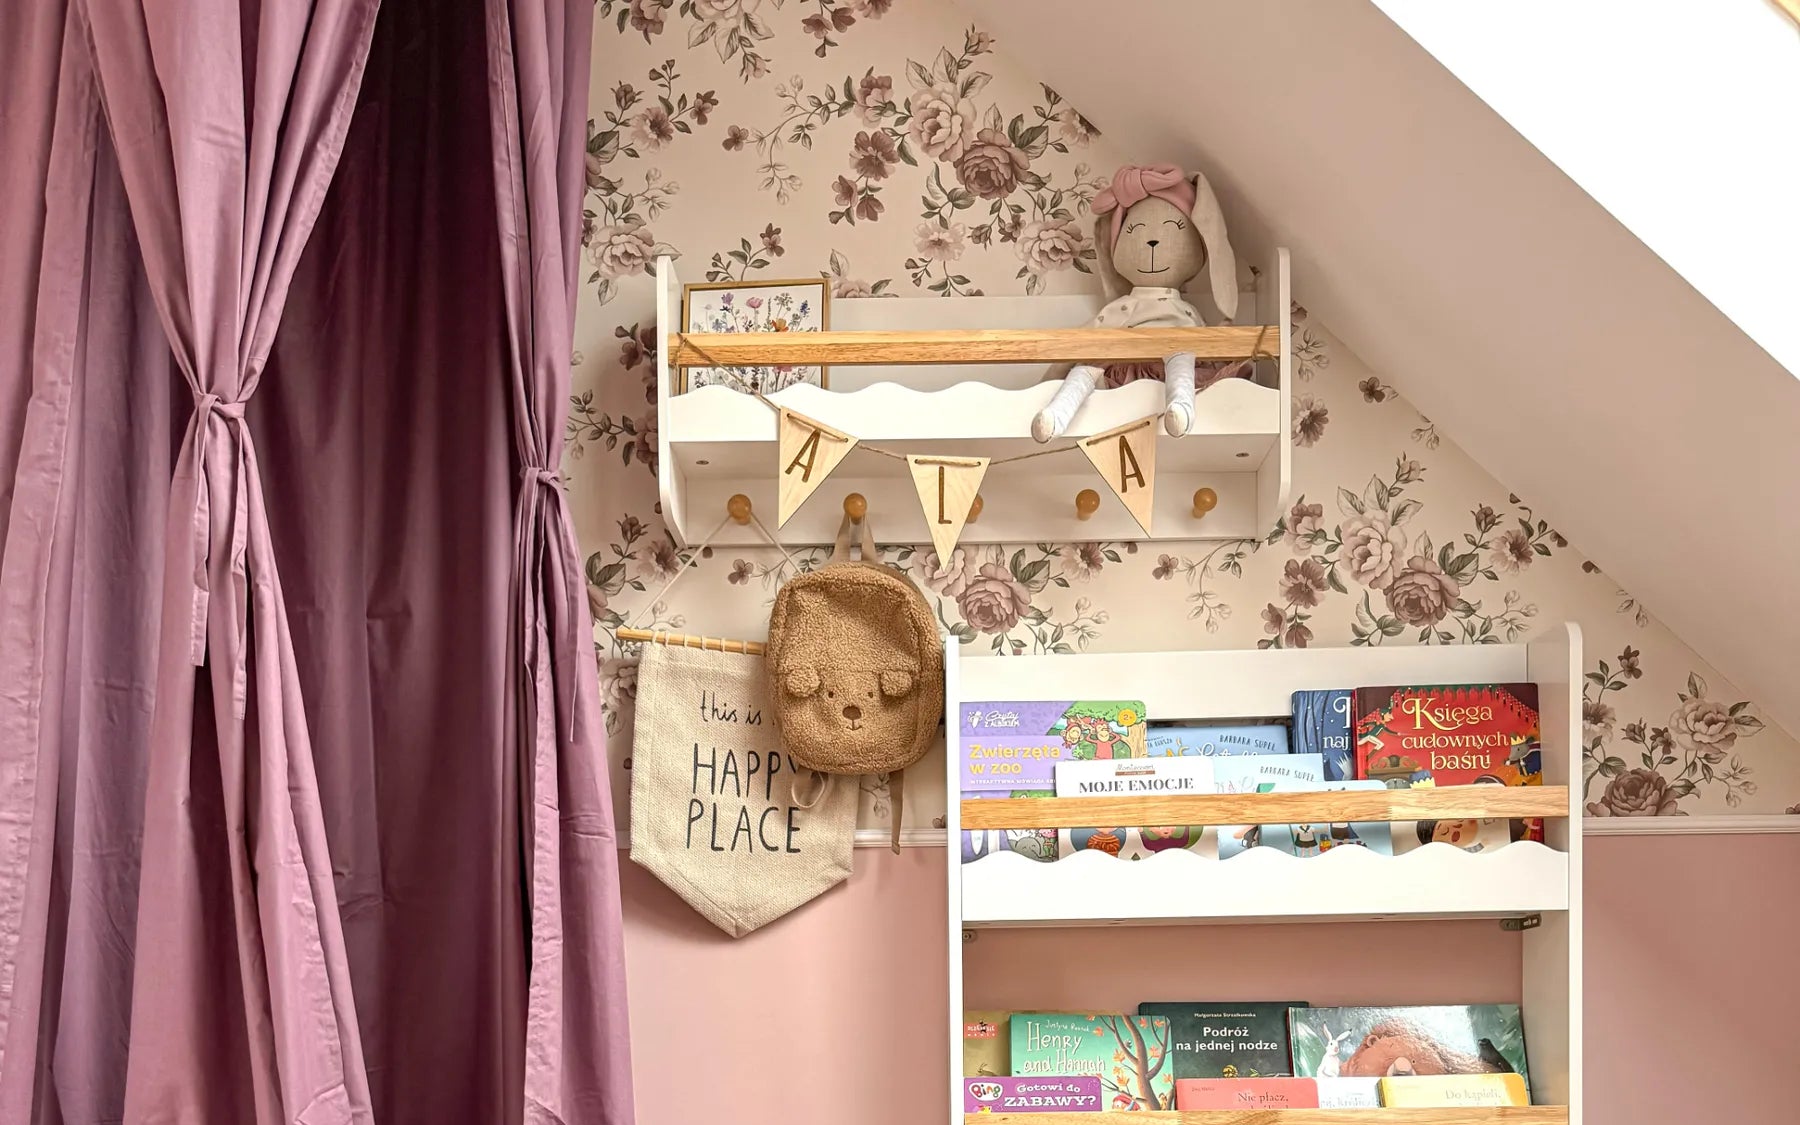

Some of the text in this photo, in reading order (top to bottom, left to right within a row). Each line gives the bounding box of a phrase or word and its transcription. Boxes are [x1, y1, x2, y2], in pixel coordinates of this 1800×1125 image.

[700, 690, 762, 726] this is
[1402, 697, 1493, 730] Księga
[1219, 734, 1251, 746] BARBARA
[1402, 731, 1509, 749] cudownych
[968, 744, 1060, 761] Zwierzęta
[1430, 750, 1491, 770] baśni
[692, 743, 798, 800] HAPP
[969, 763, 1022, 775] w zoo
[1260, 766, 1290, 777] BARBARA
[1079, 778, 1194, 793] MOJE EMOCJE
[687, 798, 801, 853] PLACE
[1203, 1026, 1249, 1037] Podróż
[1176, 1040, 1278, 1053] na jednej nodze
[1023, 1049, 1106, 1074] and Hannah
[971, 1084, 1001, 1098] Bing
[1016, 1083, 1081, 1093] Gotowi do
[1004, 1095, 1097, 1107] ZABAWY?
[1238, 1091, 1256, 1102] Nie
